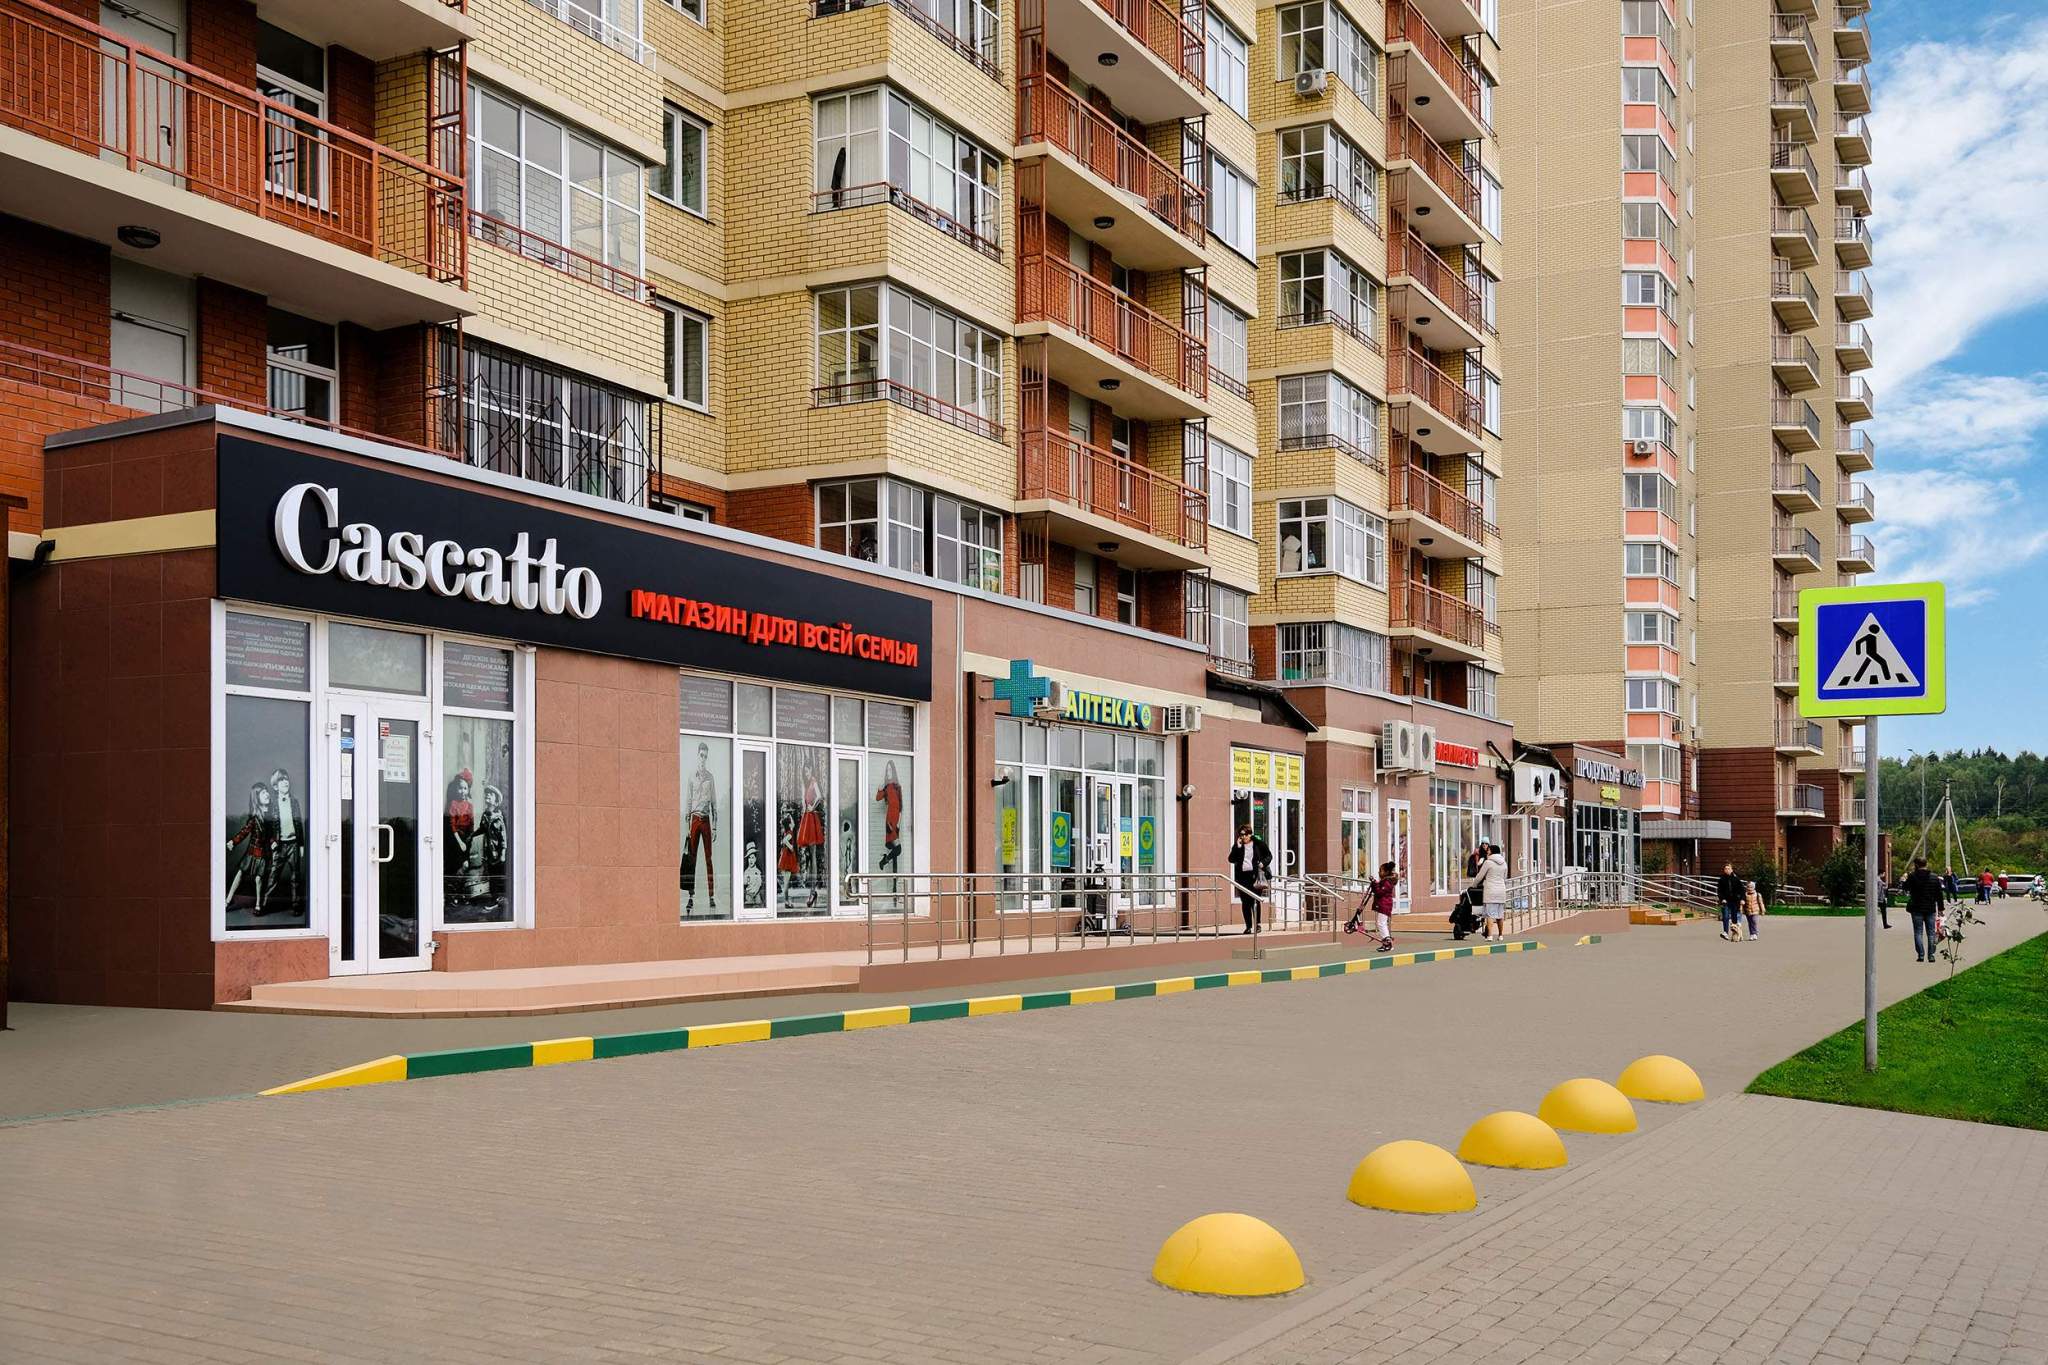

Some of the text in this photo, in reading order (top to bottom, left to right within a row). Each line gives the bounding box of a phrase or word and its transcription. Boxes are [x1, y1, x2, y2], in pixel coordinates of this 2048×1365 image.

[274, 482, 602, 620] Cascatto
[631, 588, 919, 668] МАГАЗИН ДЛЯ ВСЕЙ СЕМЬИ
[1065, 690, 1136, 727] АПТЕКА
[1575, 757, 1616, 785] ПРОДУКТЫ
[1054, 816, 1066, 839] 24
[1122, 835, 1131, 848] 24
